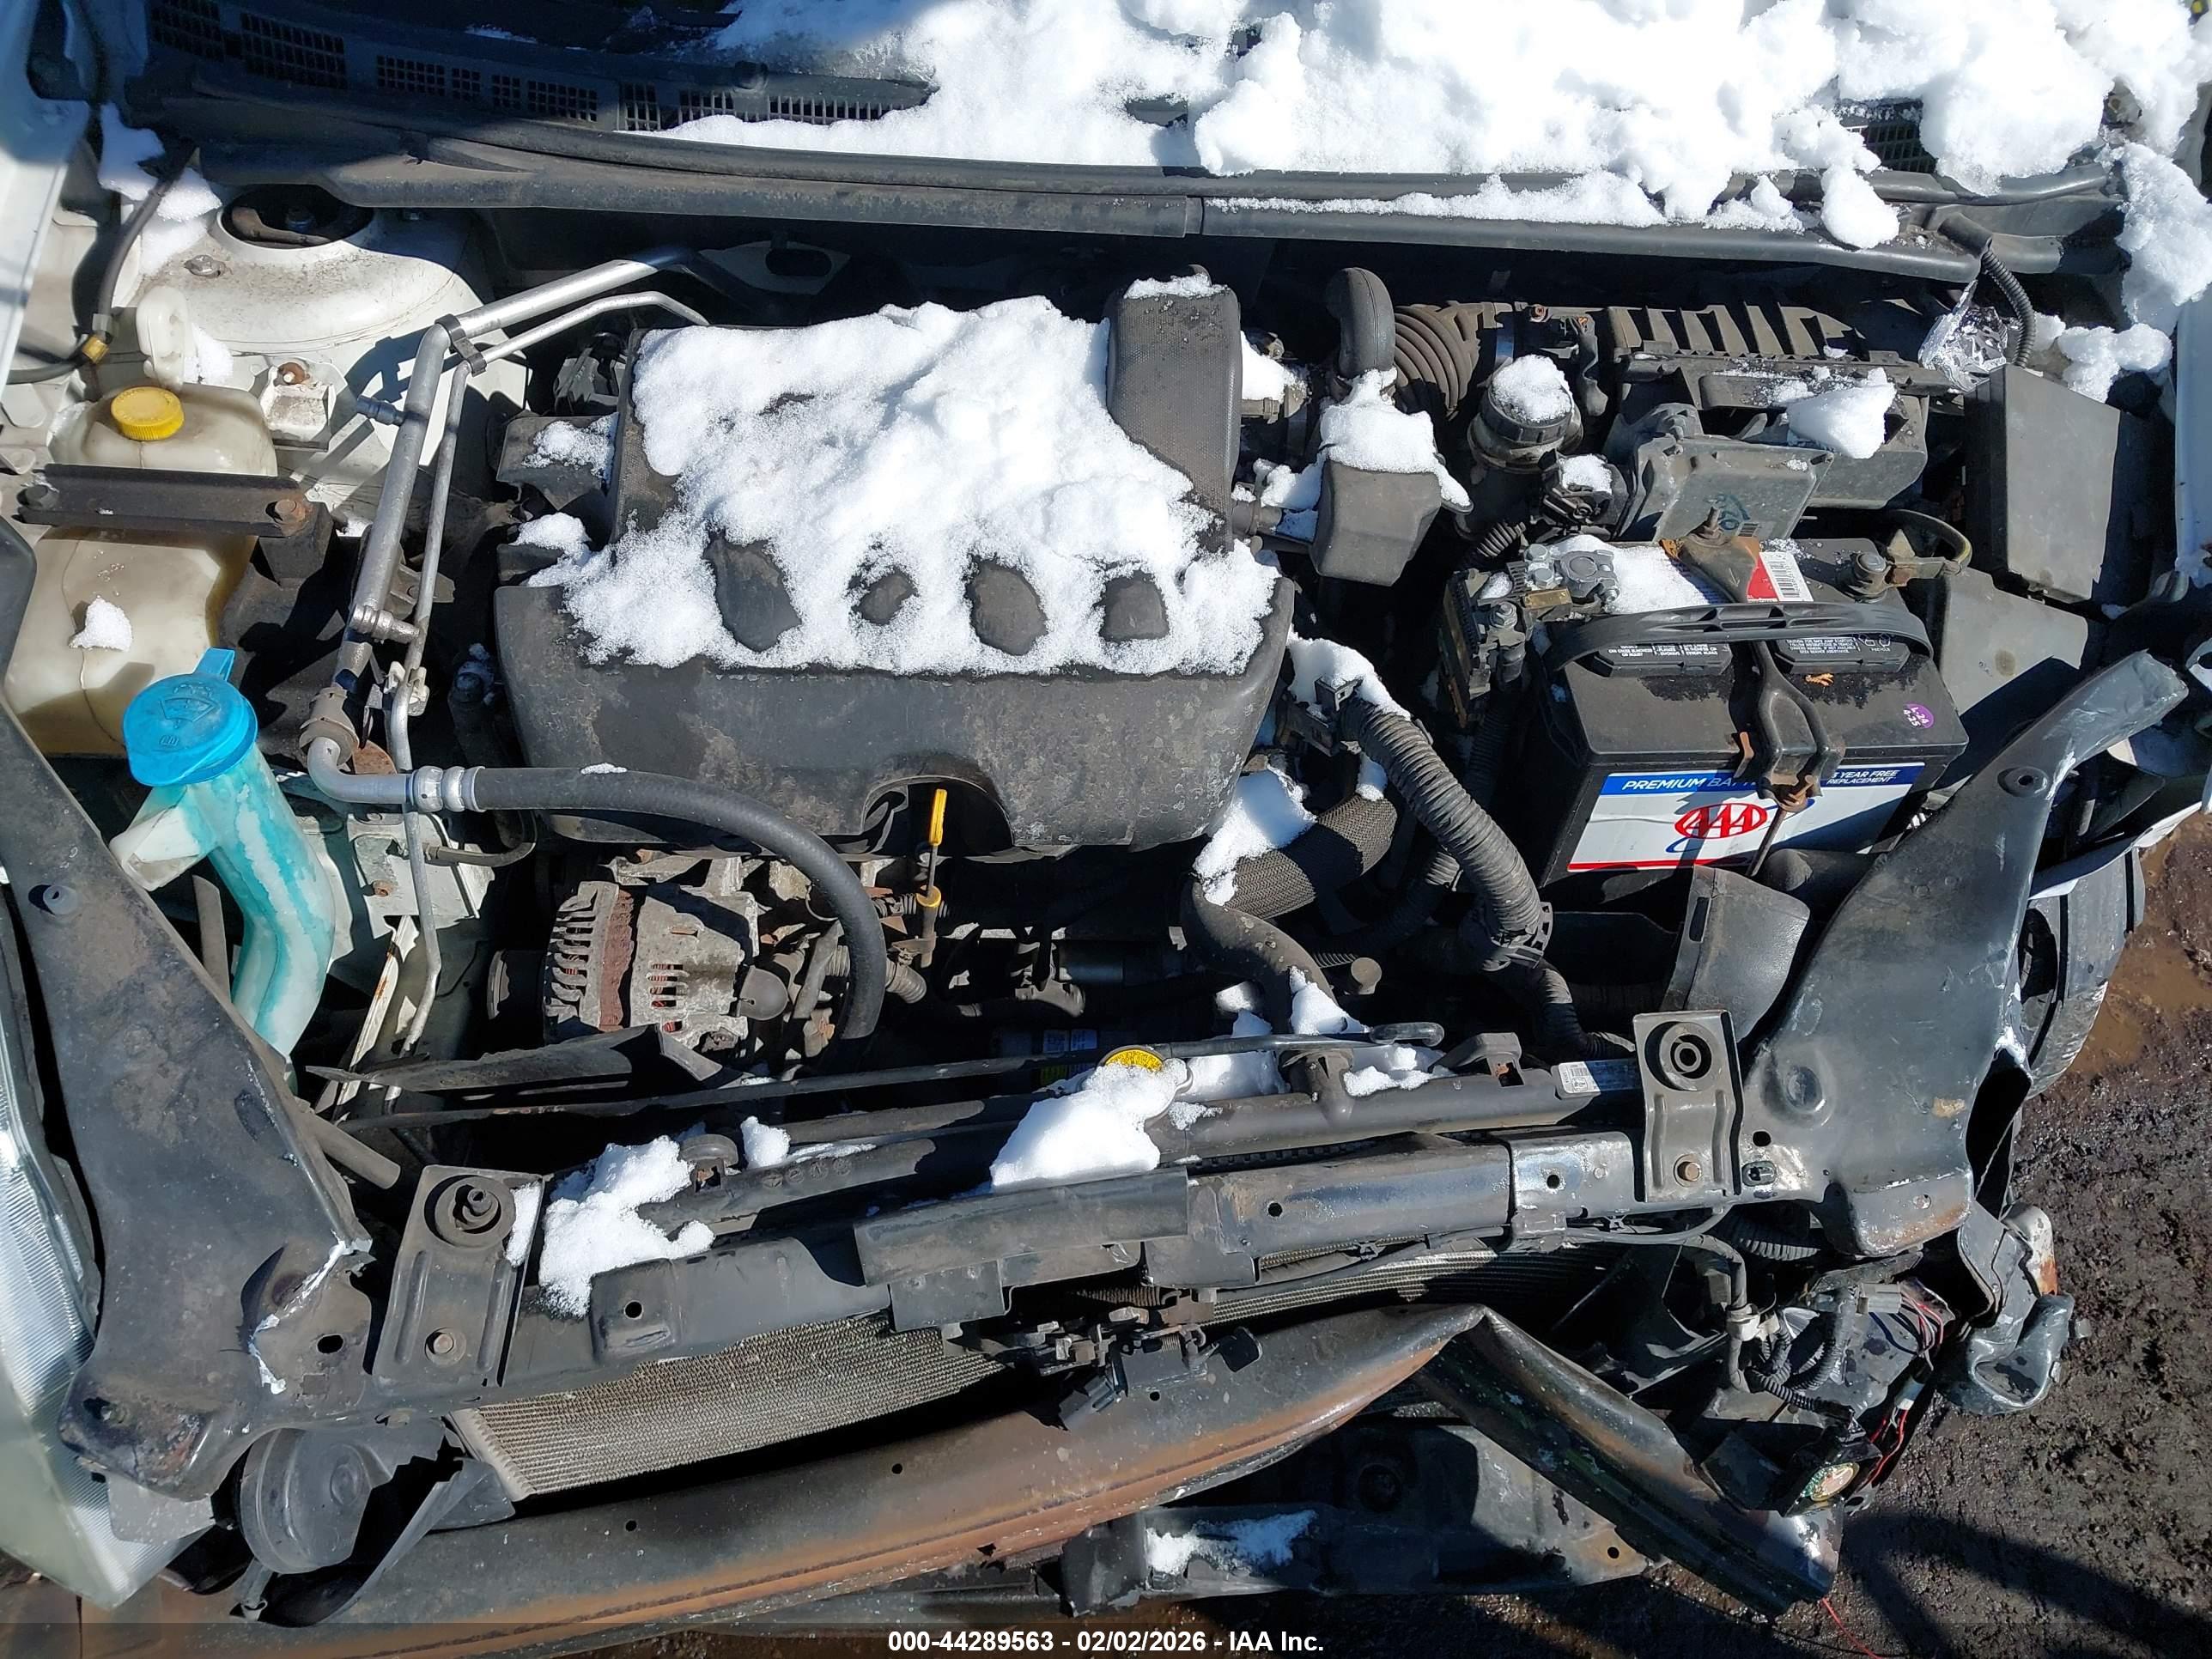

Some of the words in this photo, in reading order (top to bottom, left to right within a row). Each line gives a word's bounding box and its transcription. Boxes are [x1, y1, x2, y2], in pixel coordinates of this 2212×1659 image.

[1869, 769, 1901, 778] FREE
[1621, 777, 1707, 790] PREMIUM
[1676, 804, 1766, 838] AAA
